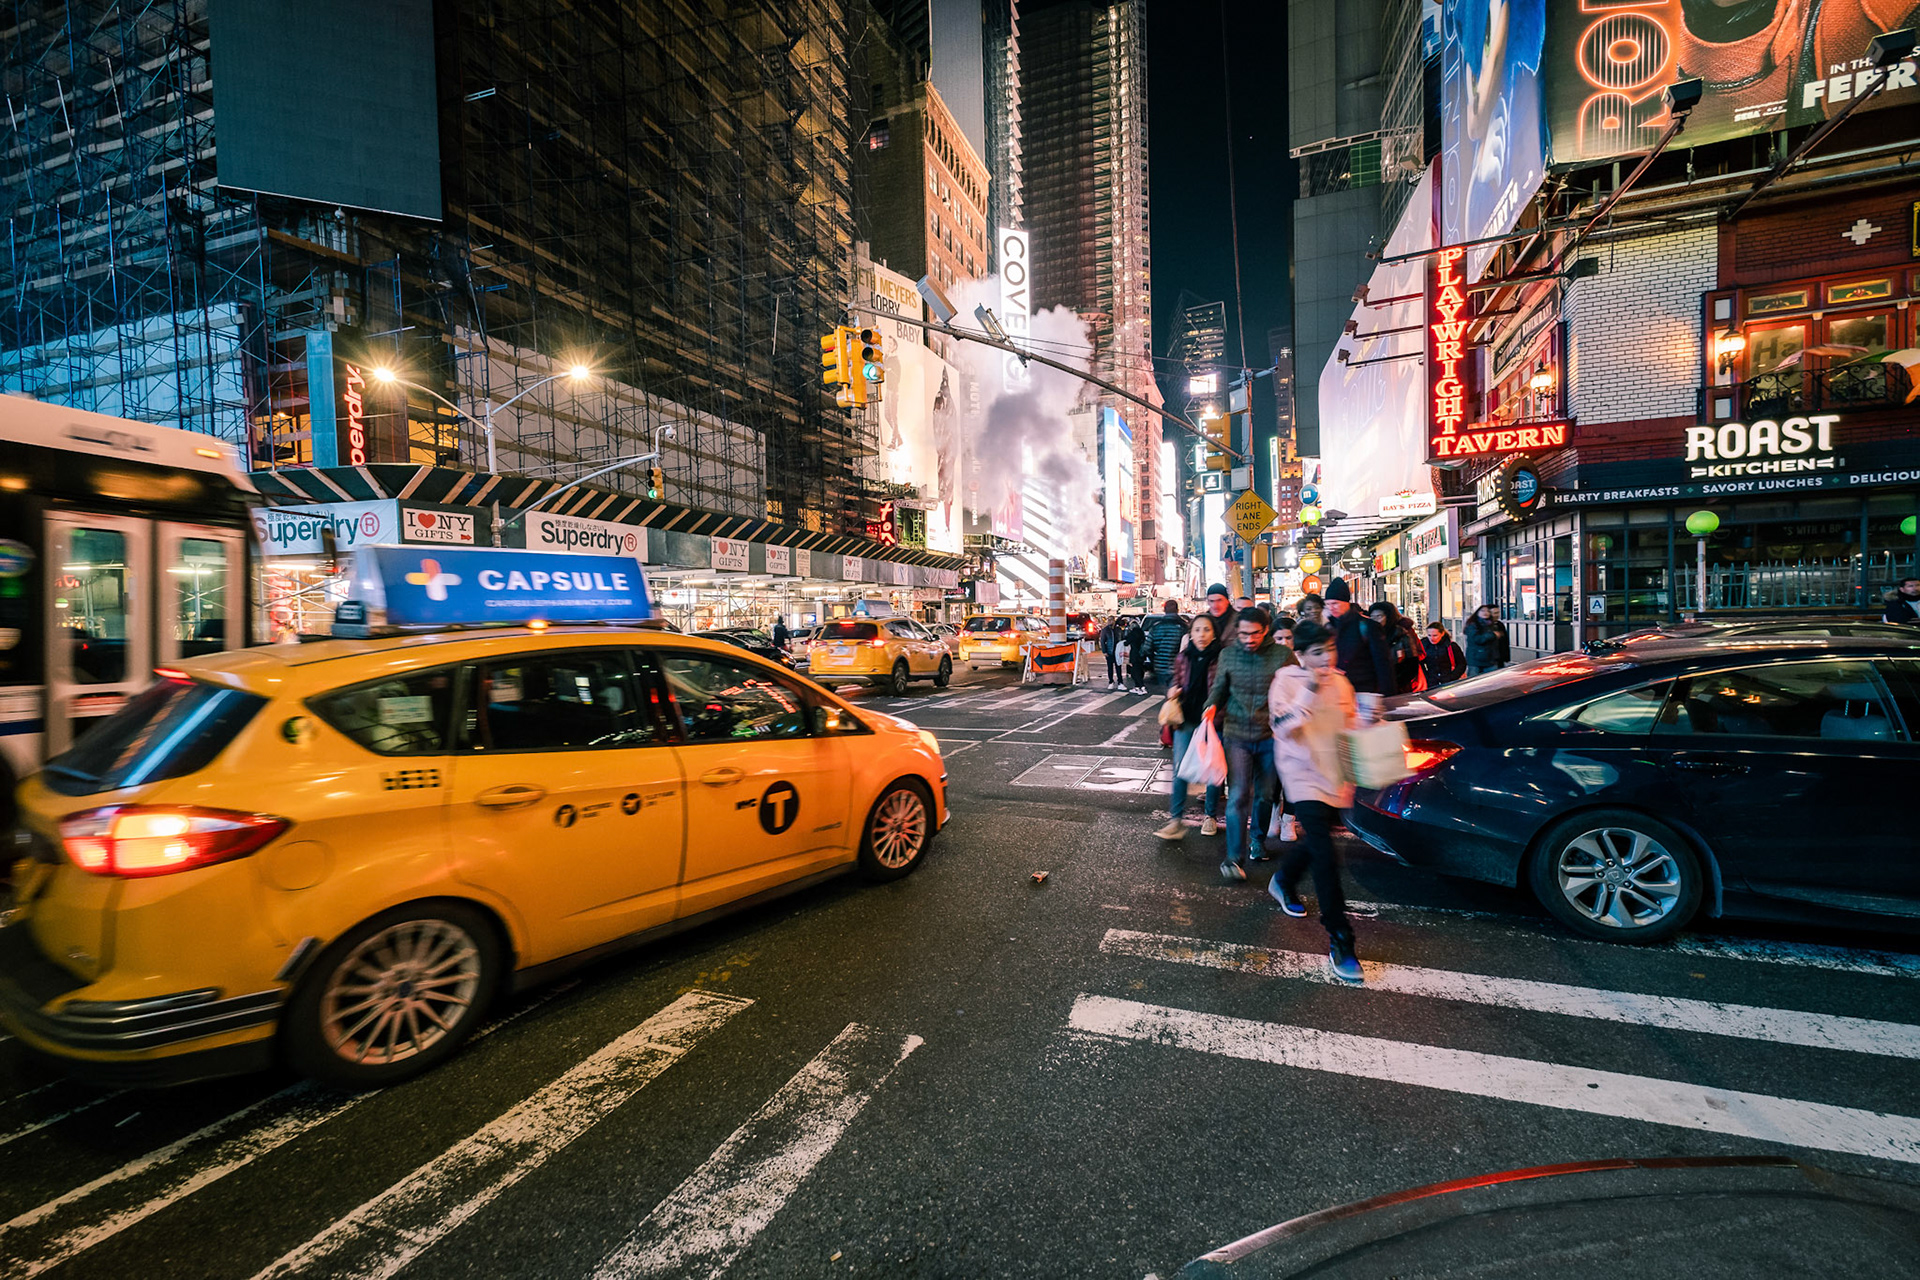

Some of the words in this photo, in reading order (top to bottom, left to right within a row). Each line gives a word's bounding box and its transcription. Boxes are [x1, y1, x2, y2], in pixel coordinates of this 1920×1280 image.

[1830, 63, 1846, 75] IN
[880, 277, 918, 309] MEYERS
[870, 291, 900, 316] LOBBY
[896, 321, 920, 346] BABY
[1431, 247, 1467, 434] PLAYWRIGHT
[1431, 425, 1566, 457] TAVERN
[1684, 414, 1841, 462] ROAST
[1708, 458, 1817, 478] KITCHEN
[1850, 470, 1920, 484] DELICIOU
[1702, 481, 1754, 494] SAVORY
[1758, 477, 1823, 490] LUNCHES
[1554, 492, 1600, 503] HEARTY
[1603, 487, 1680, 501] BREAKFASTS
[1235, 501, 1262, 510] RIGHT
[1383, 503, 1405, 511] RAY'S
[1408, 502, 1432, 510] PIZZA
[407, 511, 417, 527] I
[437, 515, 471, 531] NY
[1236, 512, 1261, 521] LANE
[414, 528, 454, 540] GIFTS
[1237, 522, 1260, 531] ENDS
[712, 539, 718, 554] I
[728, 541, 748, 557] NY
[766, 548, 770, 559] I
[776, 550, 788, 561] NY
[718, 557, 743, 568] GIFTS
[769, 561, 787, 570] GIFTS
[477, 569, 631, 591] CAPSULE
[1592, 599, 1602, 610] A
[767, 789, 793, 829] T
